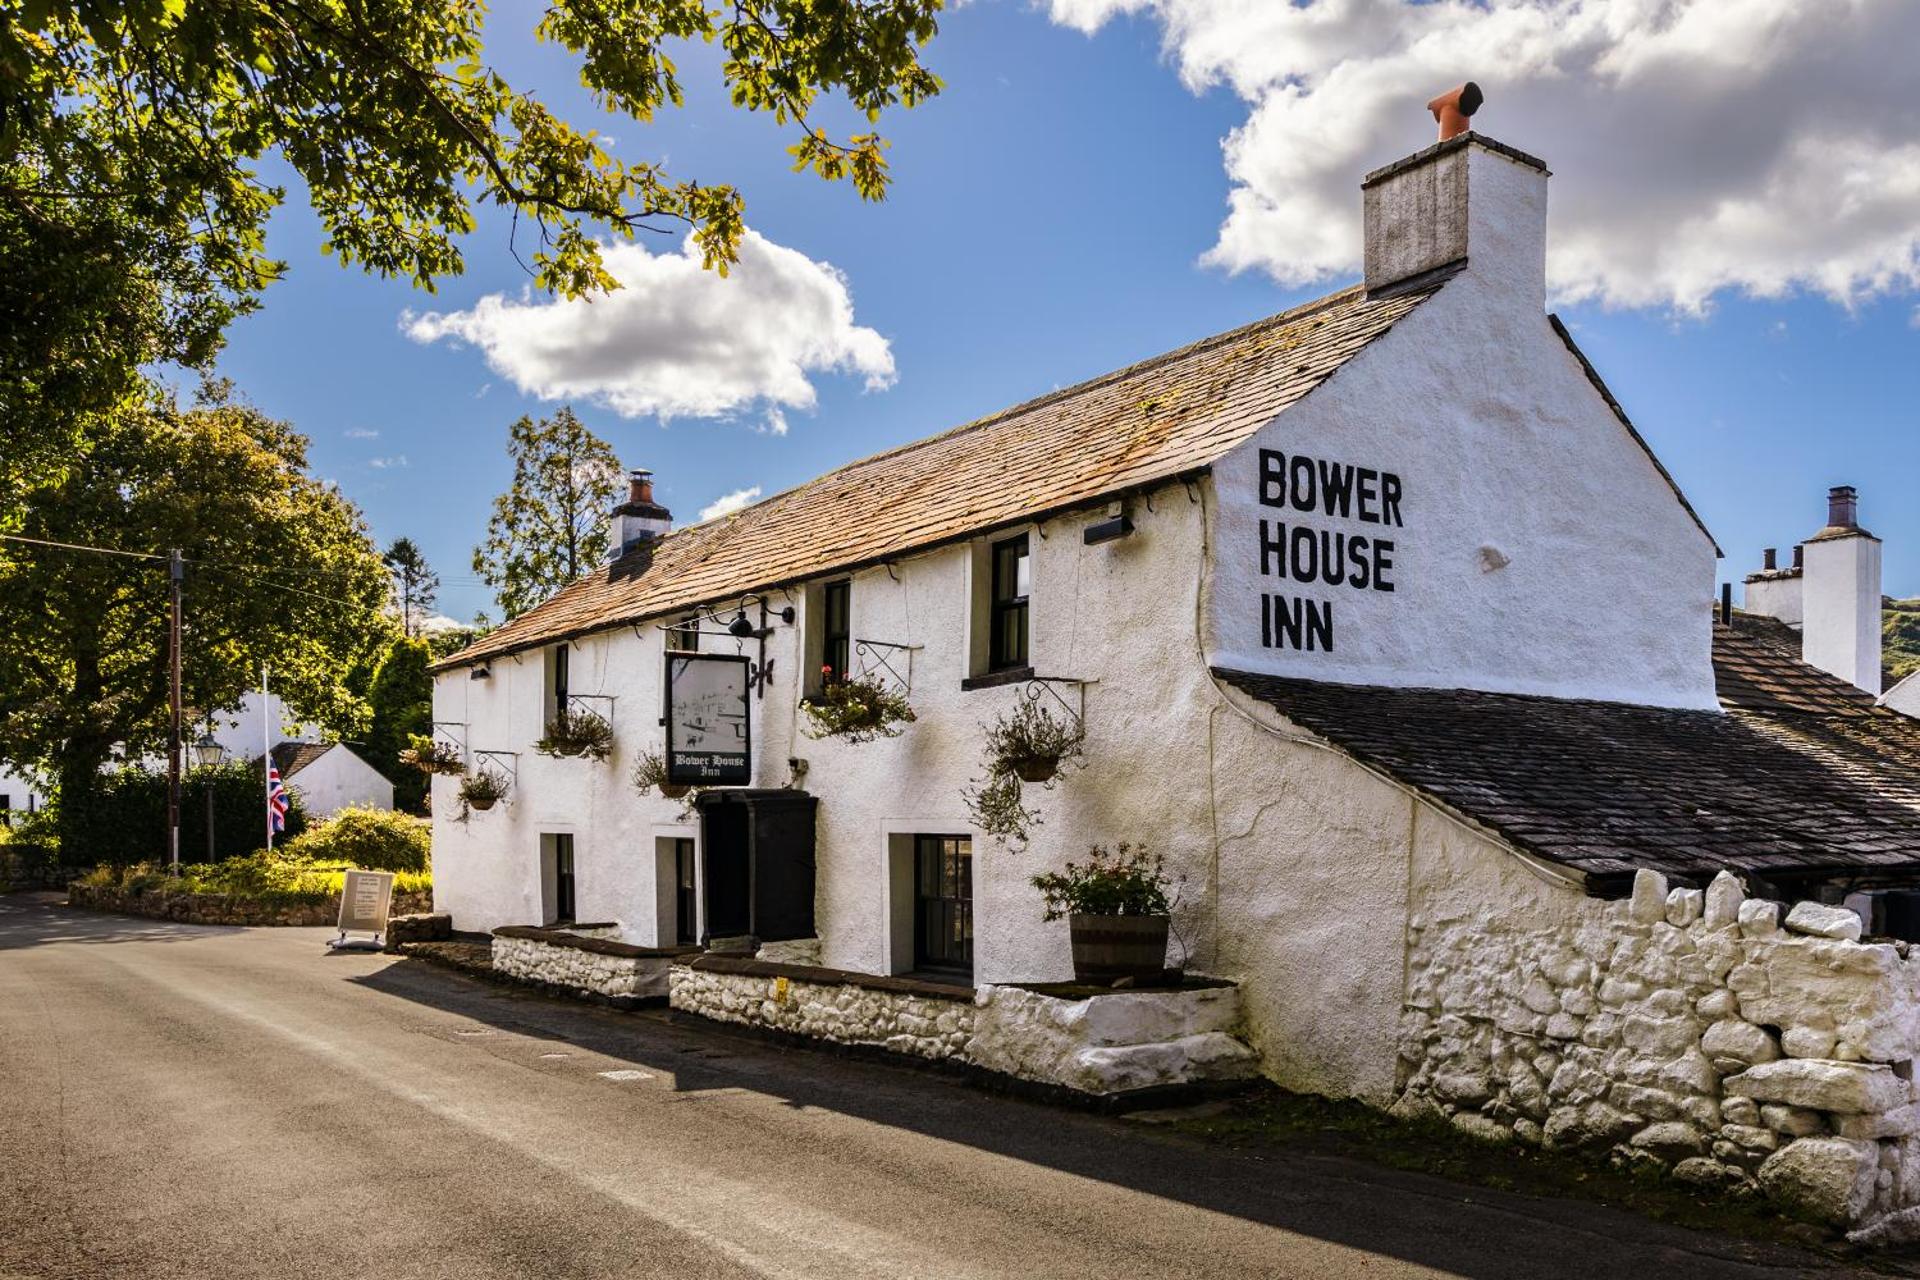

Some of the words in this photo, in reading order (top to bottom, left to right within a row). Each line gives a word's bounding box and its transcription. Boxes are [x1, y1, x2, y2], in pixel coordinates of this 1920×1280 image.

[1258, 447, 1404, 528] BOWER
[1259, 519, 1395, 593] HOUSE
[1260, 593, 1334, 653] INN
[675, 754, 709, 766] Bower
[712, 754, 745, 767] House
[700, 766, 720, 777] Inn
